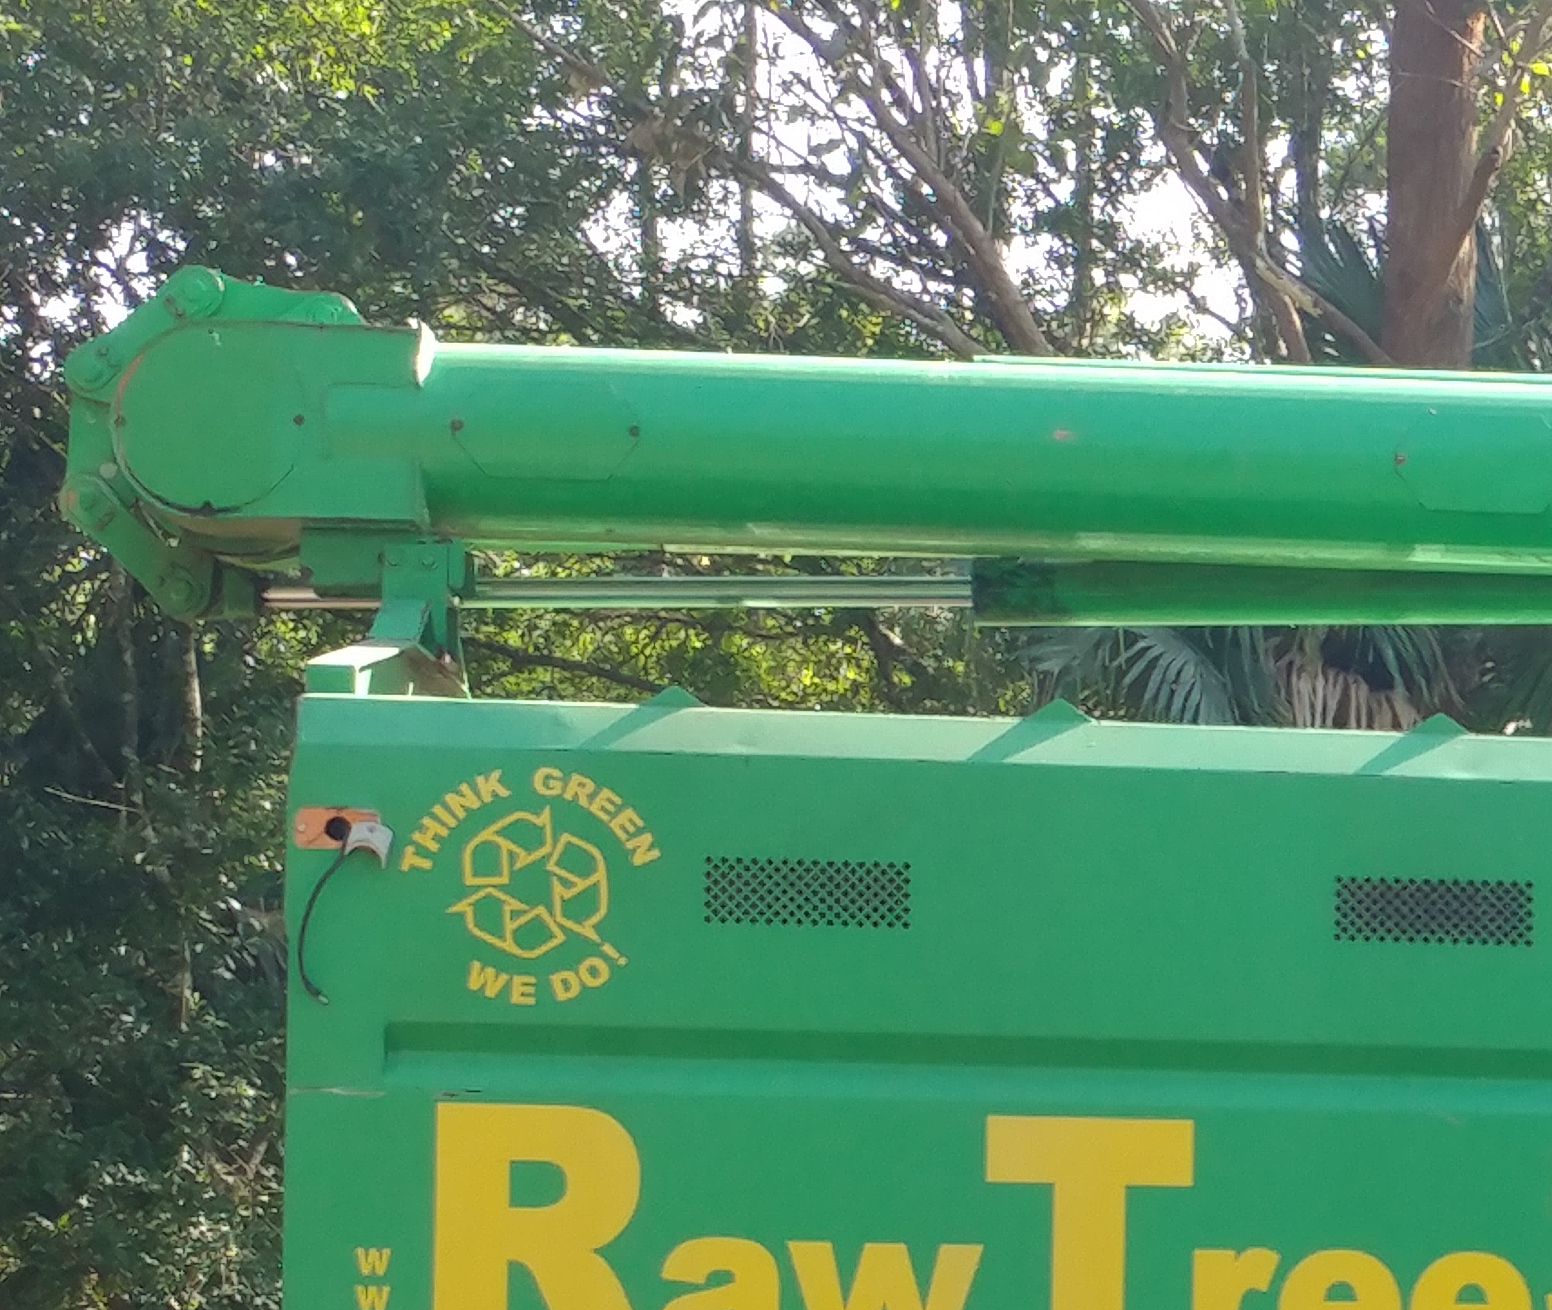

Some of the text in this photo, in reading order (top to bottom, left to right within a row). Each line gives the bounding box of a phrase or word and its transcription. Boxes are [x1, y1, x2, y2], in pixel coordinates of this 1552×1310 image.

[400, 767, 660, 872] THINK GREEN
[466, 942, 628, 1006] WE DO!
